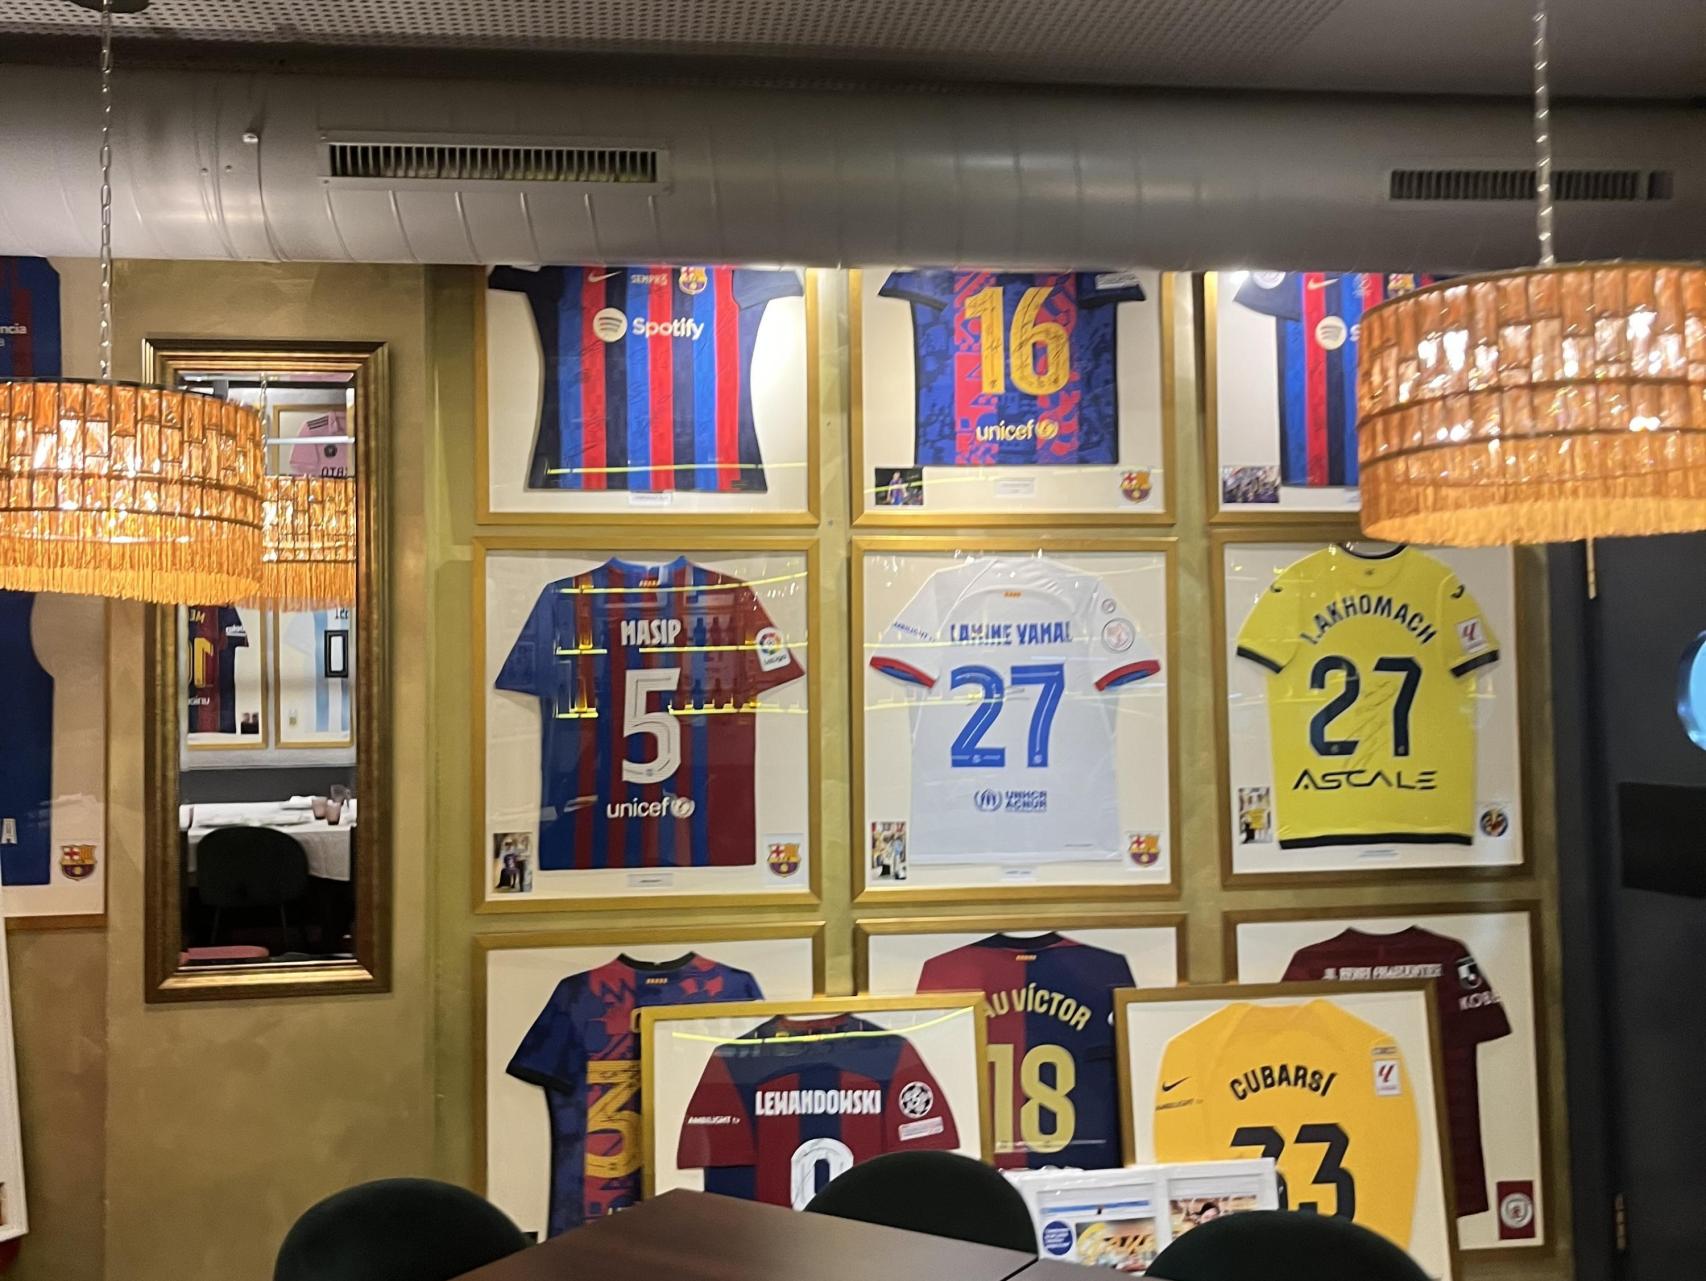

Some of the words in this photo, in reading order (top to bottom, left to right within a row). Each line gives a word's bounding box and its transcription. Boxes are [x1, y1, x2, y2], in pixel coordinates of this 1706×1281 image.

[632, 317, 705, 341] Spotify
[965, 285, 1070, 396] 16
[975, 418, 1035, 442] unicef
[620, 618, 682, 646] MASIP
[1016, 620, 1073, 646] YAMAL
[950, 663, 1065, 769] 27
[1308, 654, 1423, 758] 27
[621, 666, 682, 785] 5
[1292, 768, 1439, 791] ASCALE
[606, 797, 671, 820] unicef
[1011, 981, 1093, 1031] VÍCTOR
[755, 1089, 882, 1116] LEWANDOWSKI
[986, 1043, 1077, 1154] 18
